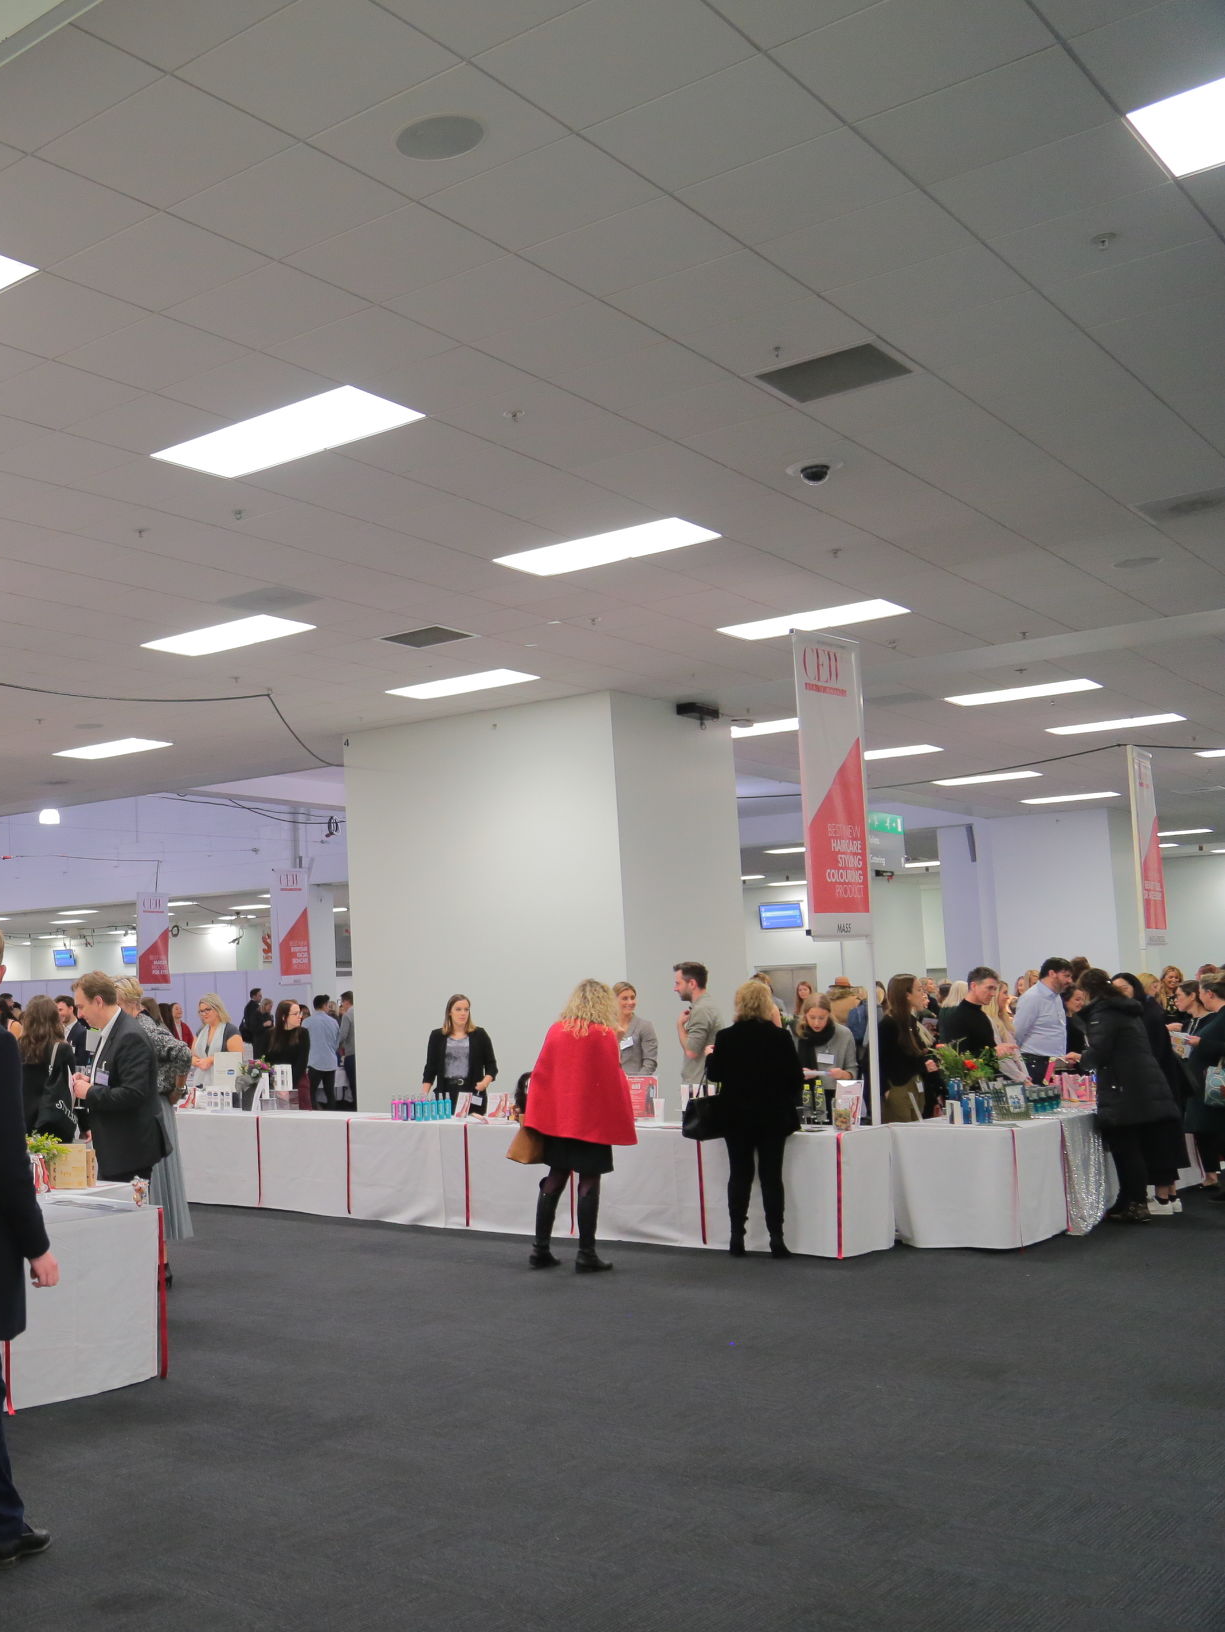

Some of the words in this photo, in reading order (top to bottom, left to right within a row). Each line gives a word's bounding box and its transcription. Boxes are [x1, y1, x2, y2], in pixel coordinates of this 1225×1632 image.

[828, 824, 841, 837] BEST
[842, 825, 861, 839] NEW
[831, 839, 862, 853] HAIRCARE
[838, 854, 863, 868] STYLING
[826, 869, 864, 883] COLOURING
[837, 923, 852, 934] MASS
